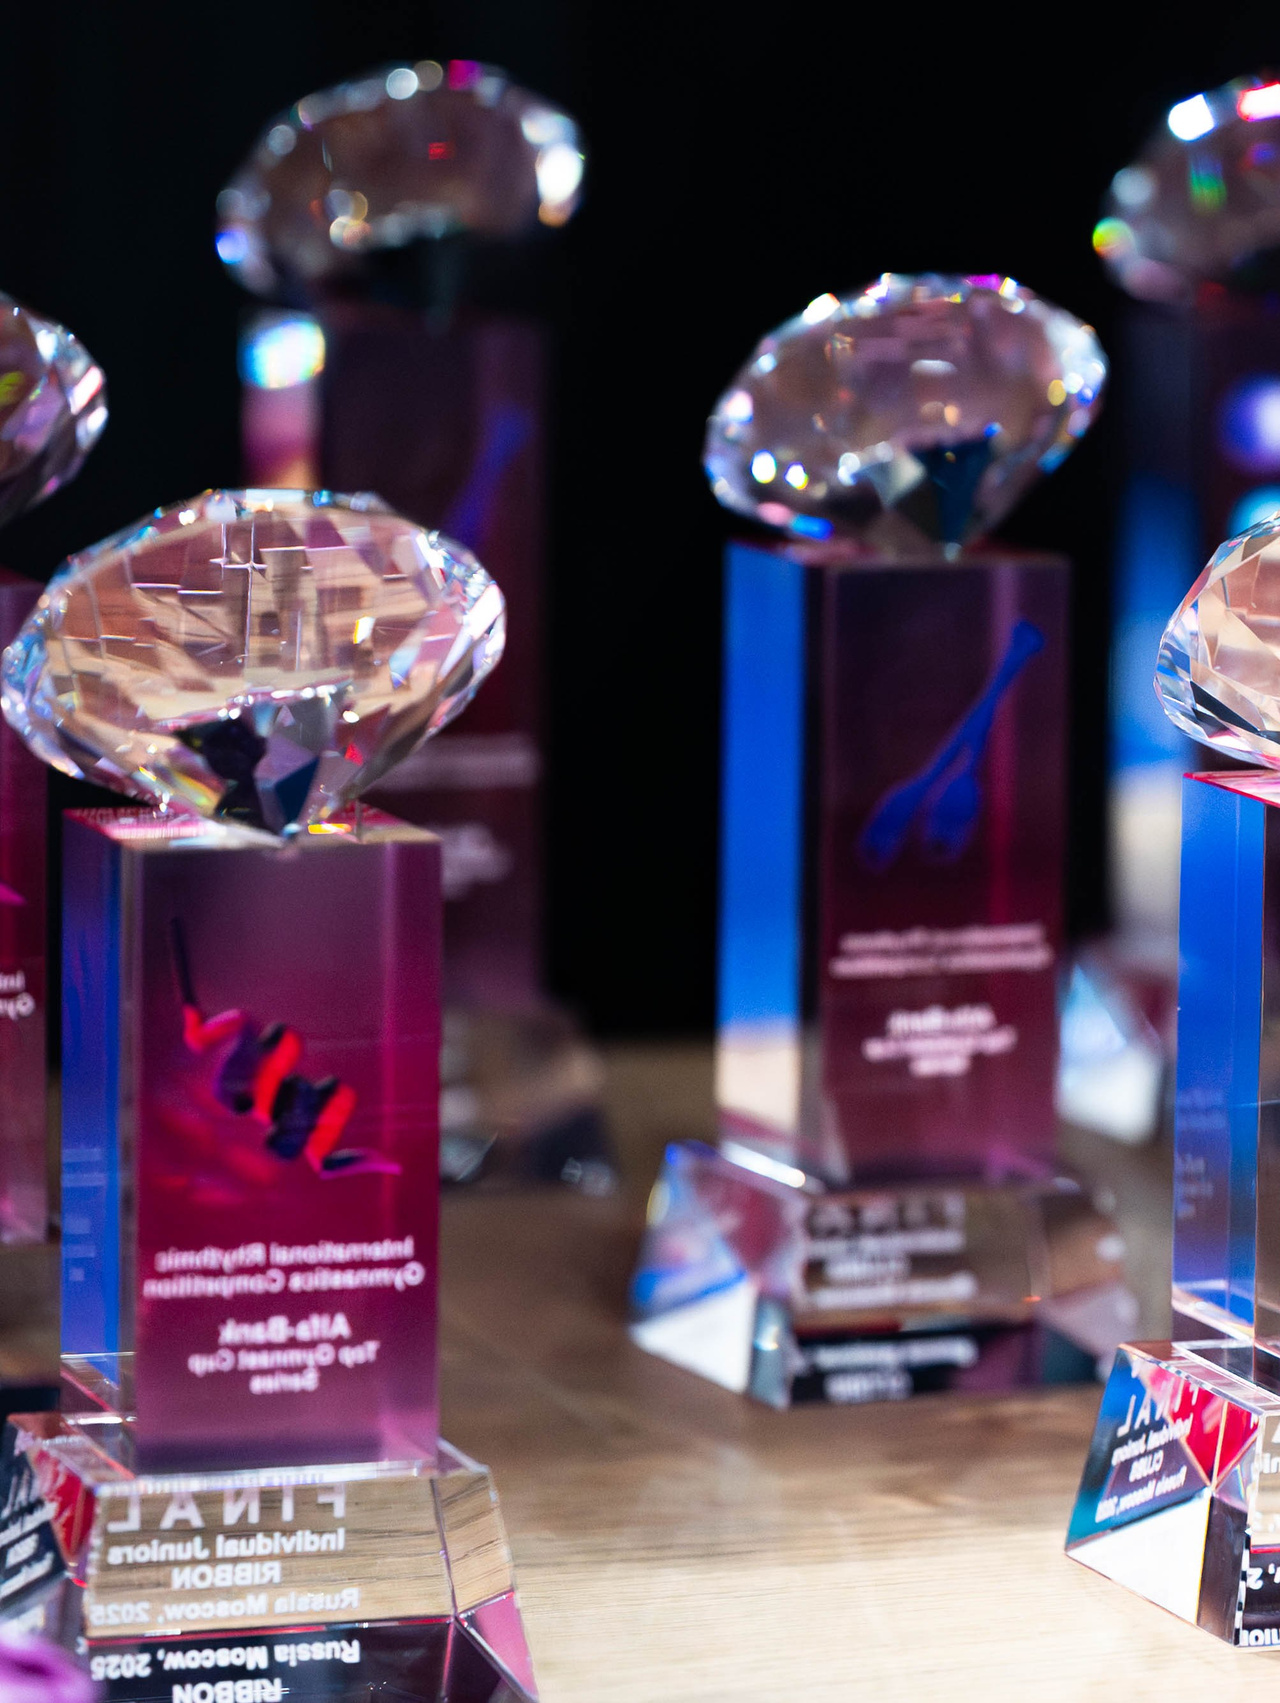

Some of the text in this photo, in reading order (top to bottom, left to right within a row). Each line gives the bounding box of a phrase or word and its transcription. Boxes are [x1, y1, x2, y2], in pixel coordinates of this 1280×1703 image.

[157, 1645, 268, 1671] Moscow,
[274, 1640, 360, 1667] Russia
[172, 1678, 282, 1703] RIBBON
